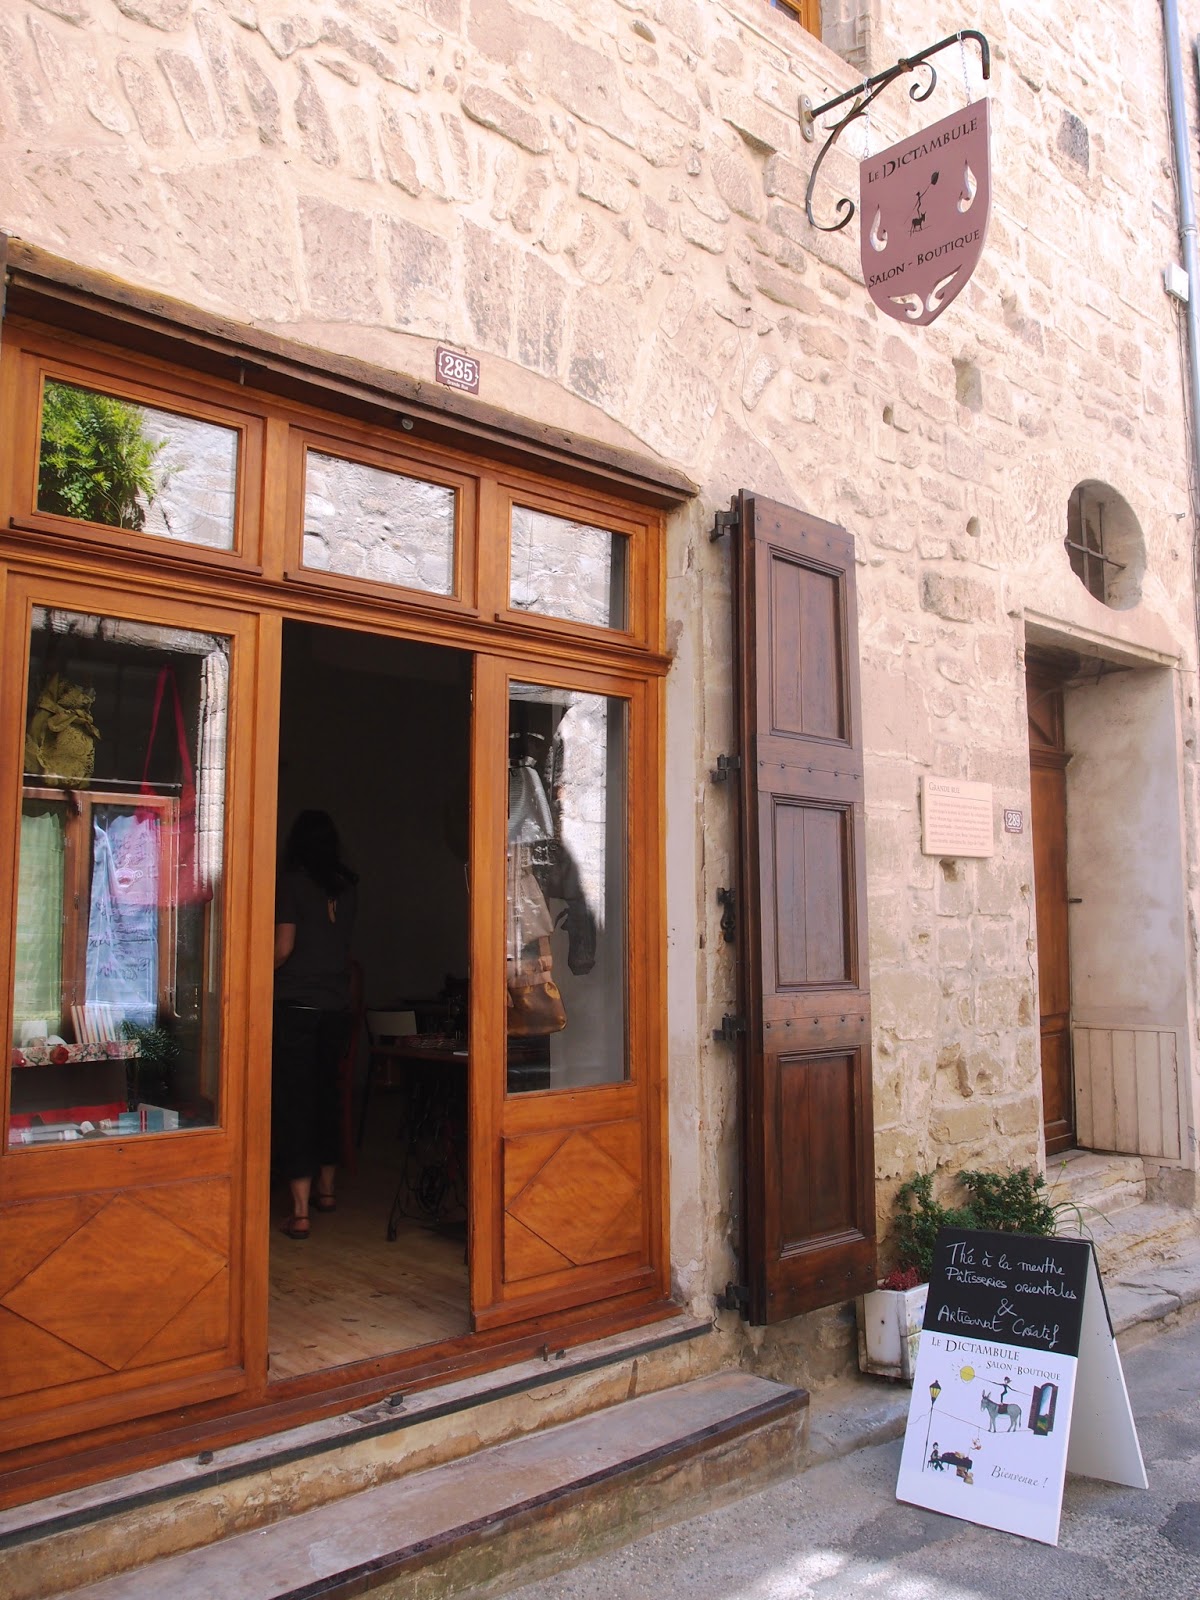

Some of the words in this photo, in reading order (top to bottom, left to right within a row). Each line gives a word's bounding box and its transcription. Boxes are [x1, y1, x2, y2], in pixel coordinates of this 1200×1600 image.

[883, 117, 978, 179] DICTAMBULE
[868, 263, 906, 289] SALON
[917, 229, 981, 266] BOUTIQUE
[444, 355, 473, 382] 285
[946, 1241, 976, 1265] Thé
[981, 1251, 992, 1268] à
[998, 1253, 1013, 1271] la
[1017, 1257, 1066, 1276] menthe
[997, 1298, 1018, 1317] &
[1012, 1318, 1060, 1349] Créatif
[945, 1339, 1020, 1361] DICTAMBULE
[986, 1360, 1013, 1371] SALON
[1017, 1366, 1061, 1381] BOUTIQUE
[991, 1464, 1040, 1487] Bienvenue
